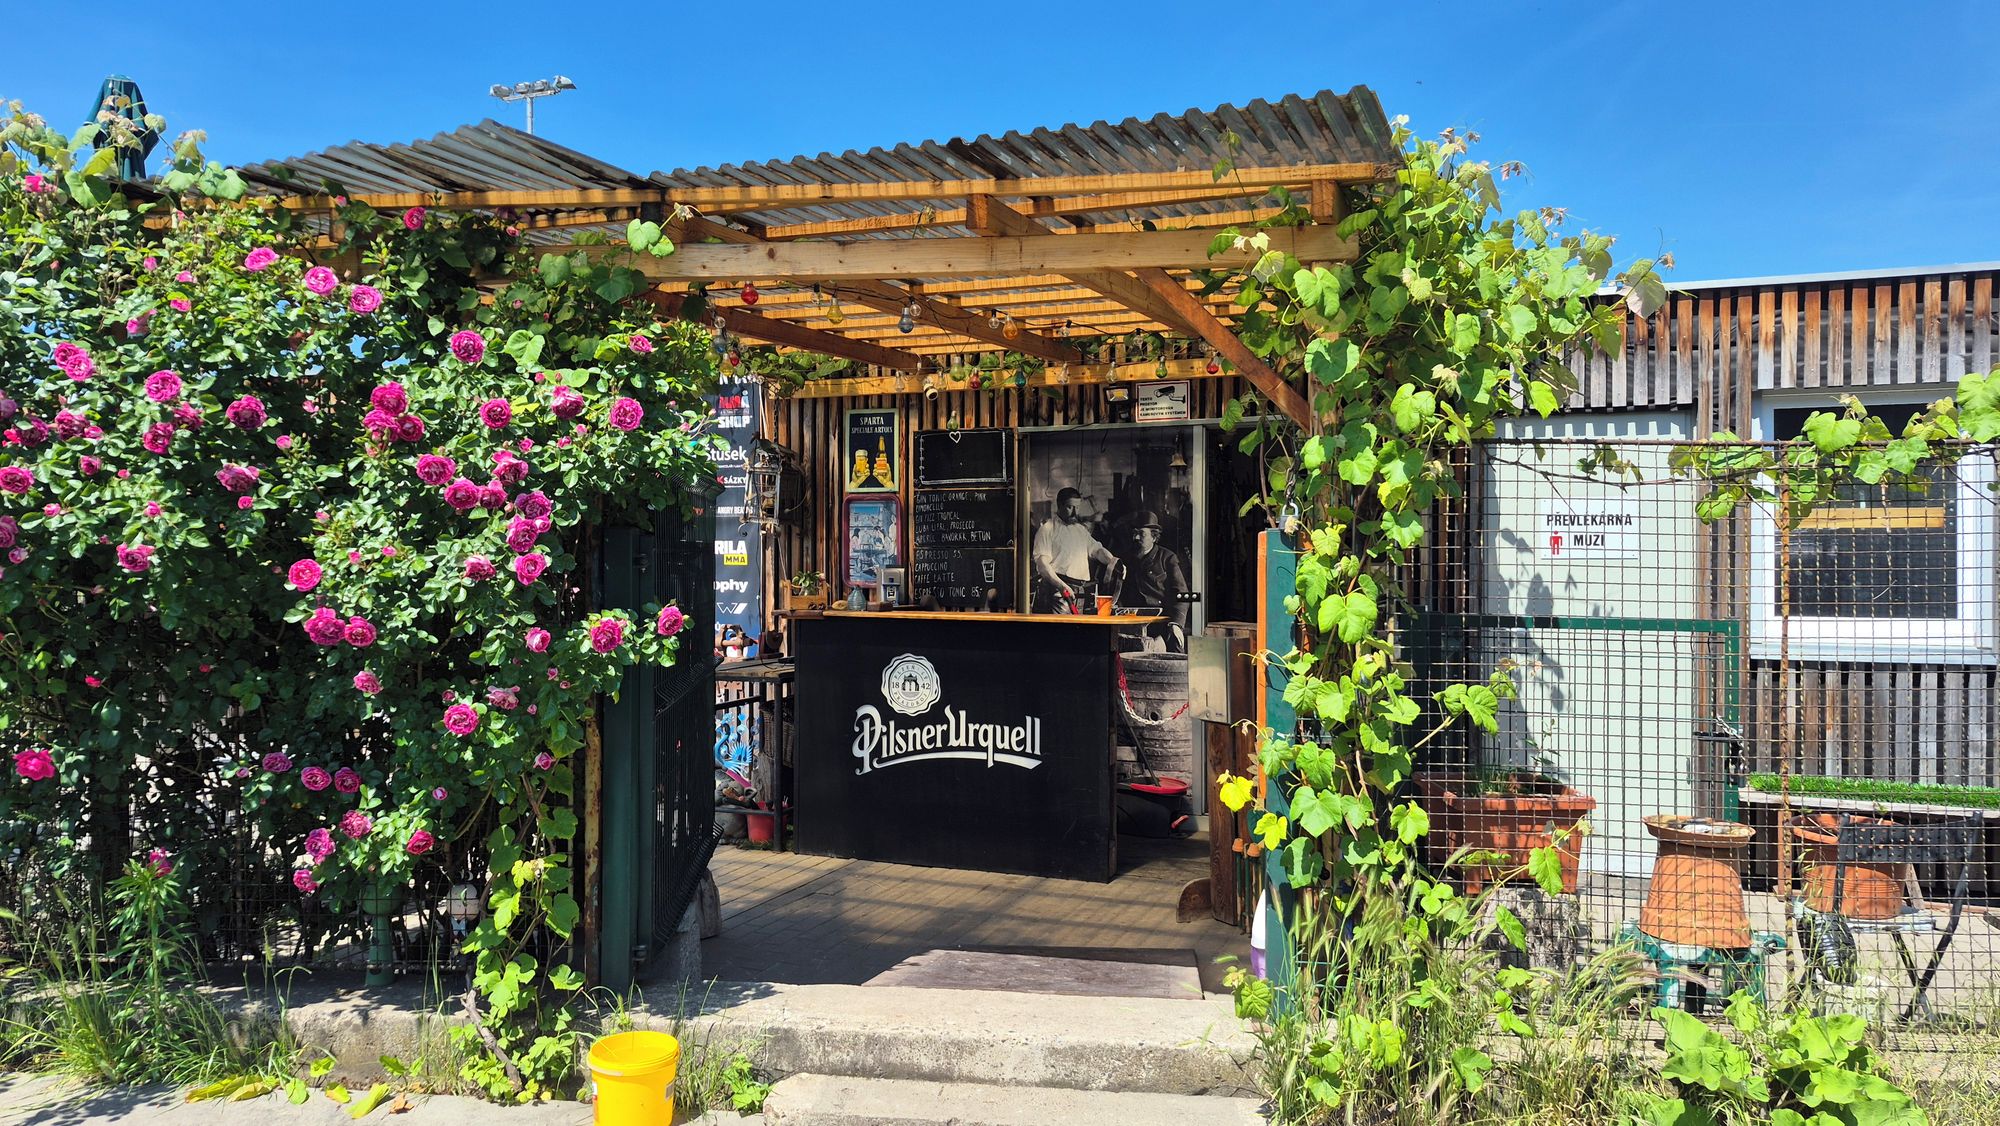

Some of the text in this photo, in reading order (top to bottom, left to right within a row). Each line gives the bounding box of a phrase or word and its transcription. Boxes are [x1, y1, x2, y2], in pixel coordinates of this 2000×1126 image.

[718, 415, 752, 429] SHOP
[860, 416, 884, 426] SPARTA
[1546, 511, 1632, 526] PŘEVLEKÁRNA
[915, 550, 949, 560] ESPRESSO
[915, 562, 948, 572] CAPPUCCINO
[933, 572, 955, 583] LATTE
[920, 682, 931, 690] 42
[852, 704, 1042, 776] Pilsner Urquell
